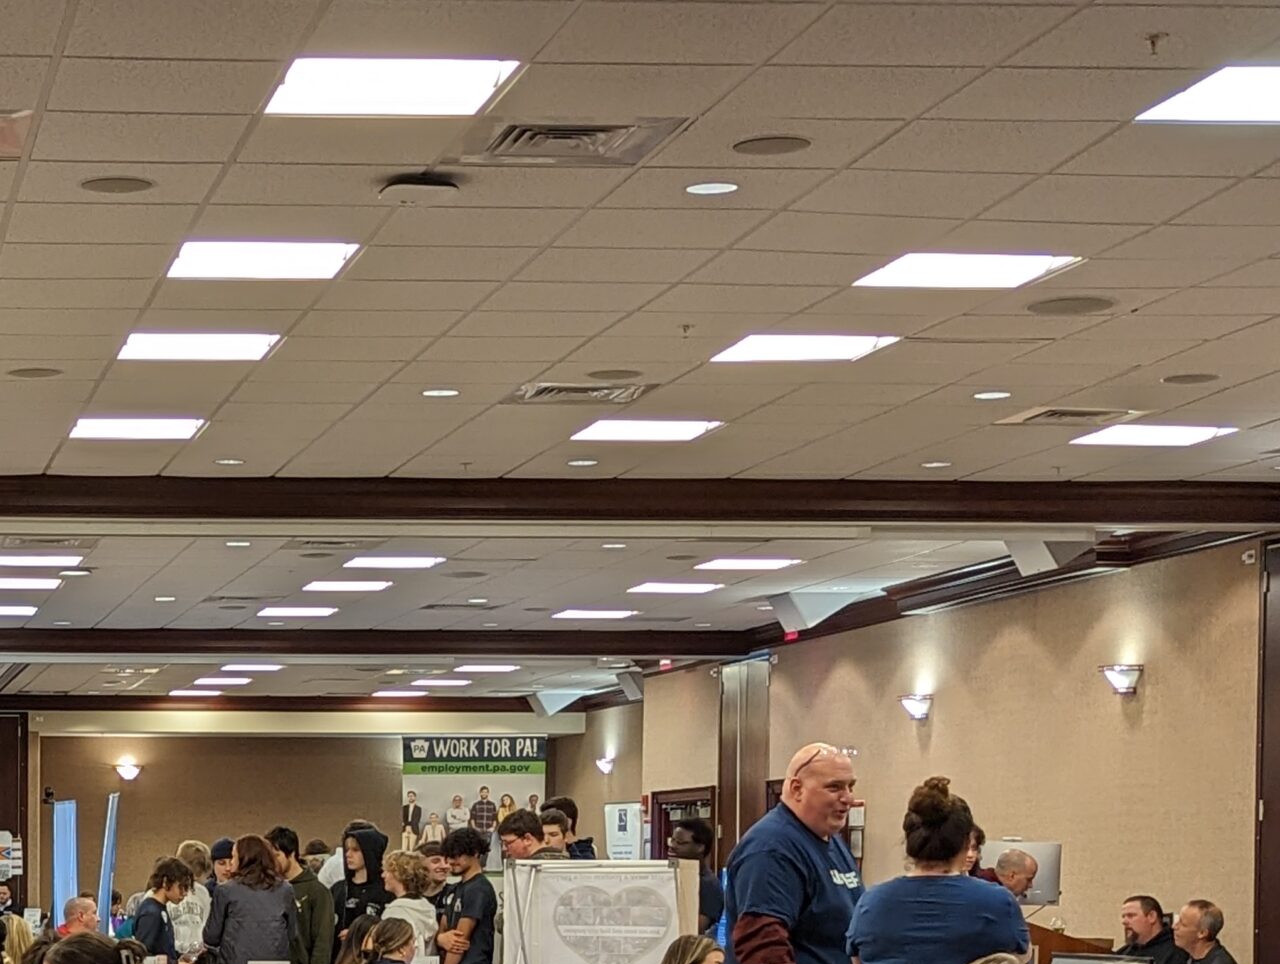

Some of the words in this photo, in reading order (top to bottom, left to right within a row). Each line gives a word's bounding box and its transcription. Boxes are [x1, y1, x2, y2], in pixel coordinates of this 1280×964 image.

[413, 745, 426, 753] PA
[433, 738, 480, 758] WORK
[483, 738, 511, 758] FOR
[515, 738, 538, 758] PA!
[420, 763, 531, 774] employment.pa.gov
